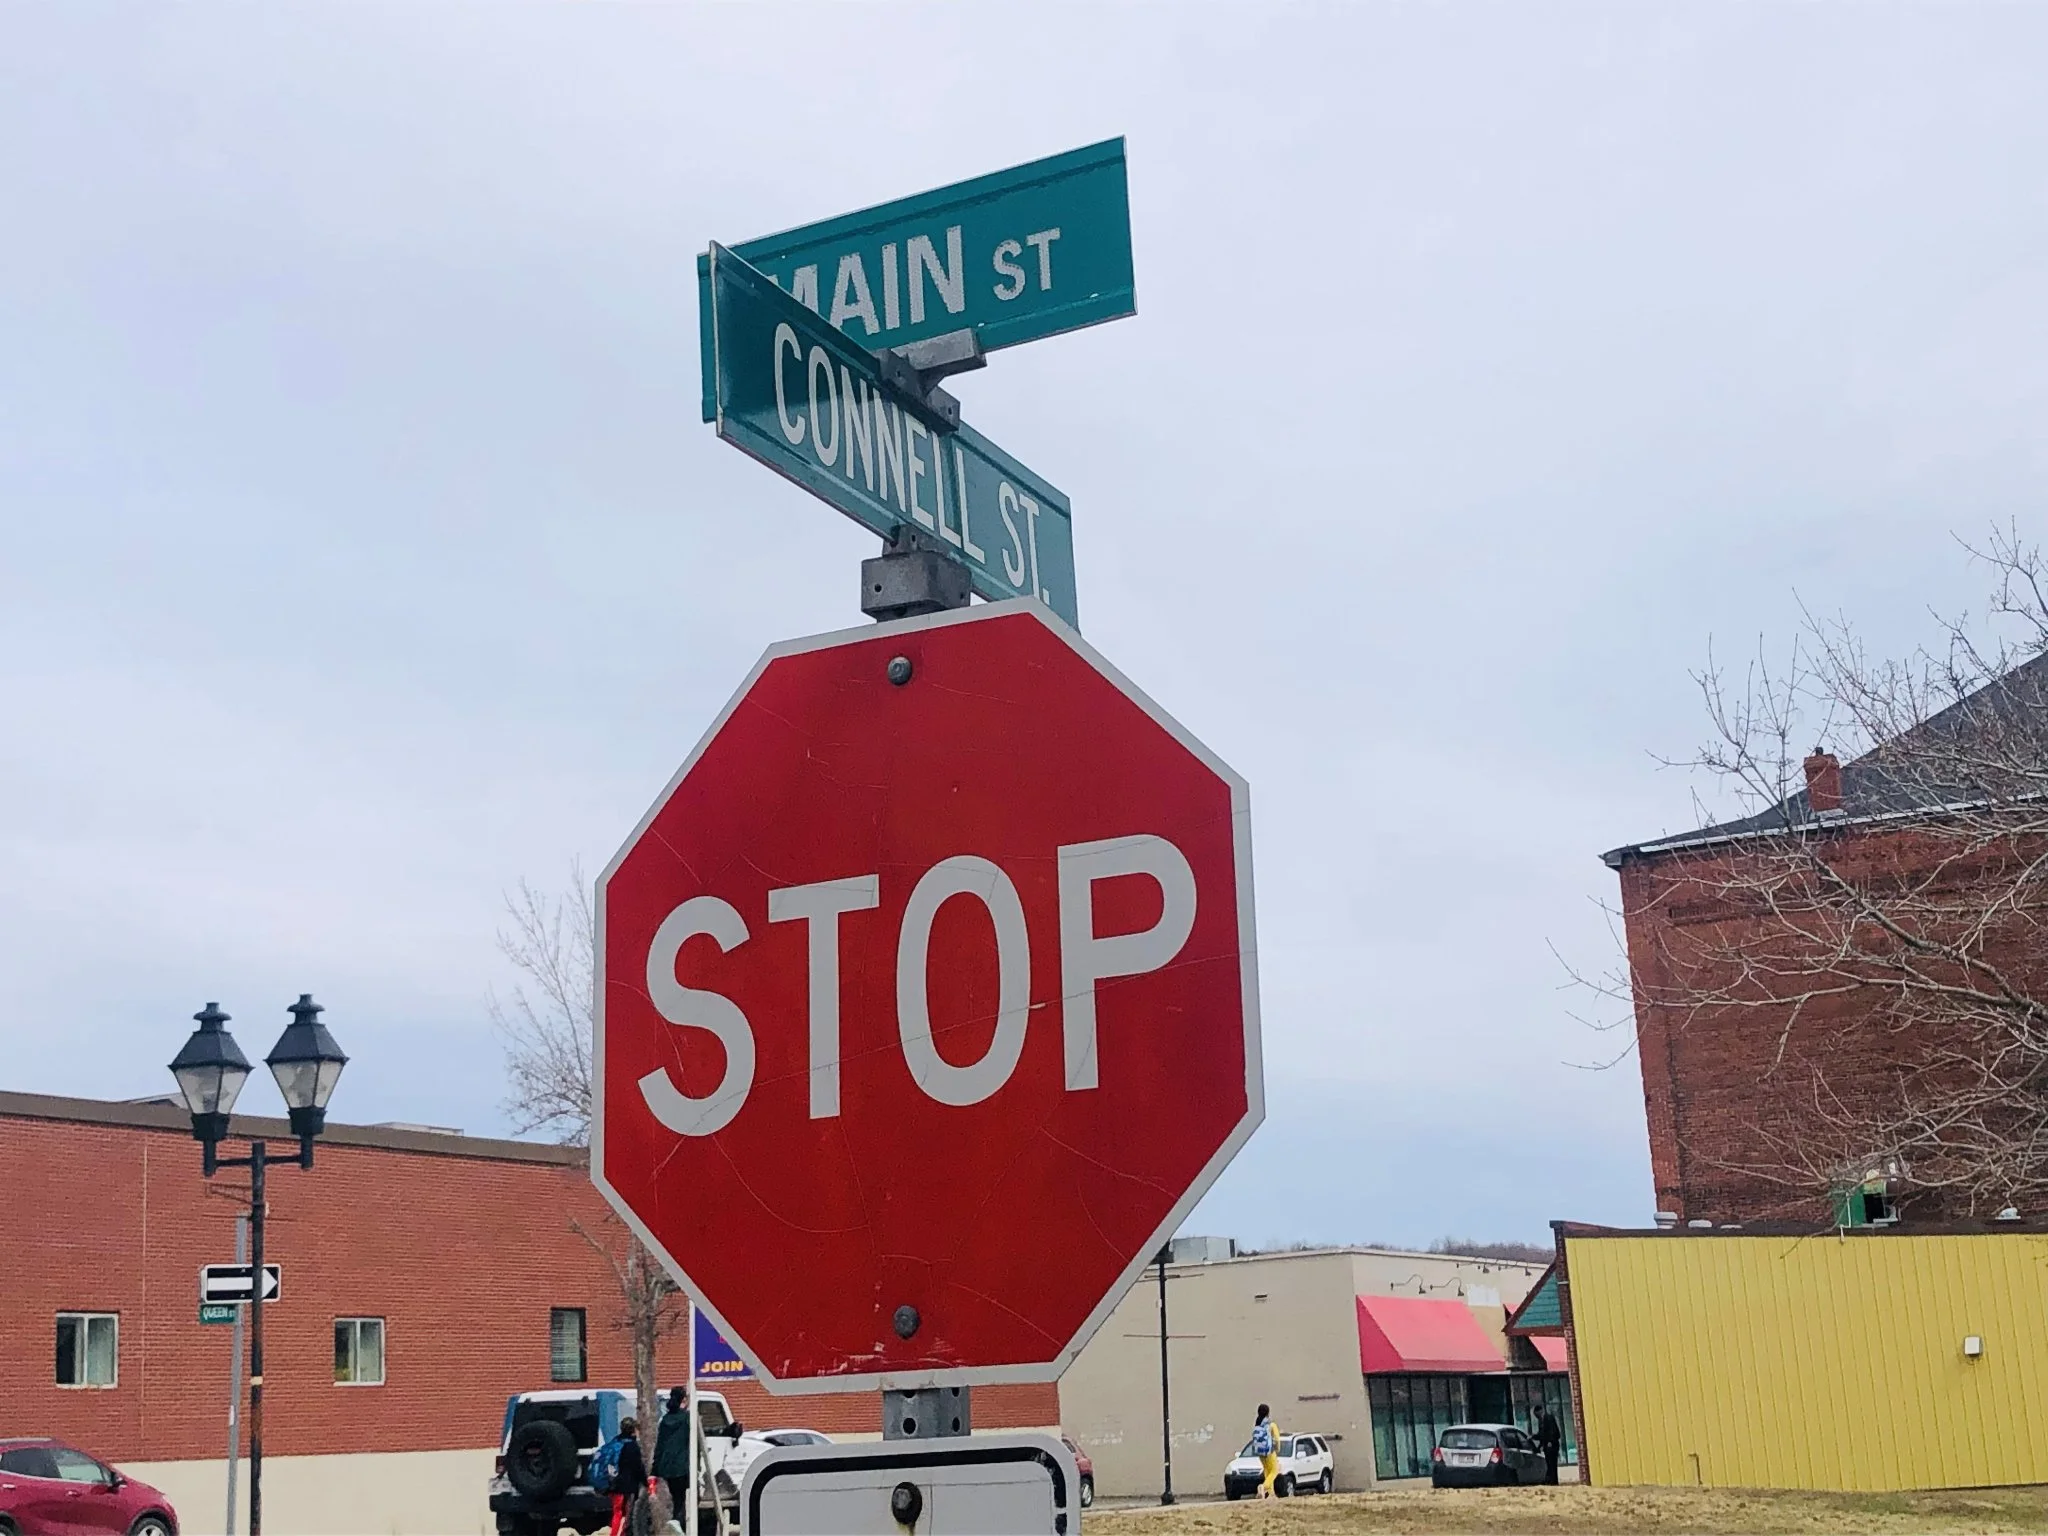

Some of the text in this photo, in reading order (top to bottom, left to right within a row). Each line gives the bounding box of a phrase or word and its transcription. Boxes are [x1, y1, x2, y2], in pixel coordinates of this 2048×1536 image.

[992, 227, 1061, 301] ST
[774, 322, 986, 565] CONNELL
[637, 833, 1198, 1137] STOP
[202, 1306, 229, 1320] QUEEN
[700, 1360, 744, 1374] JOIN
